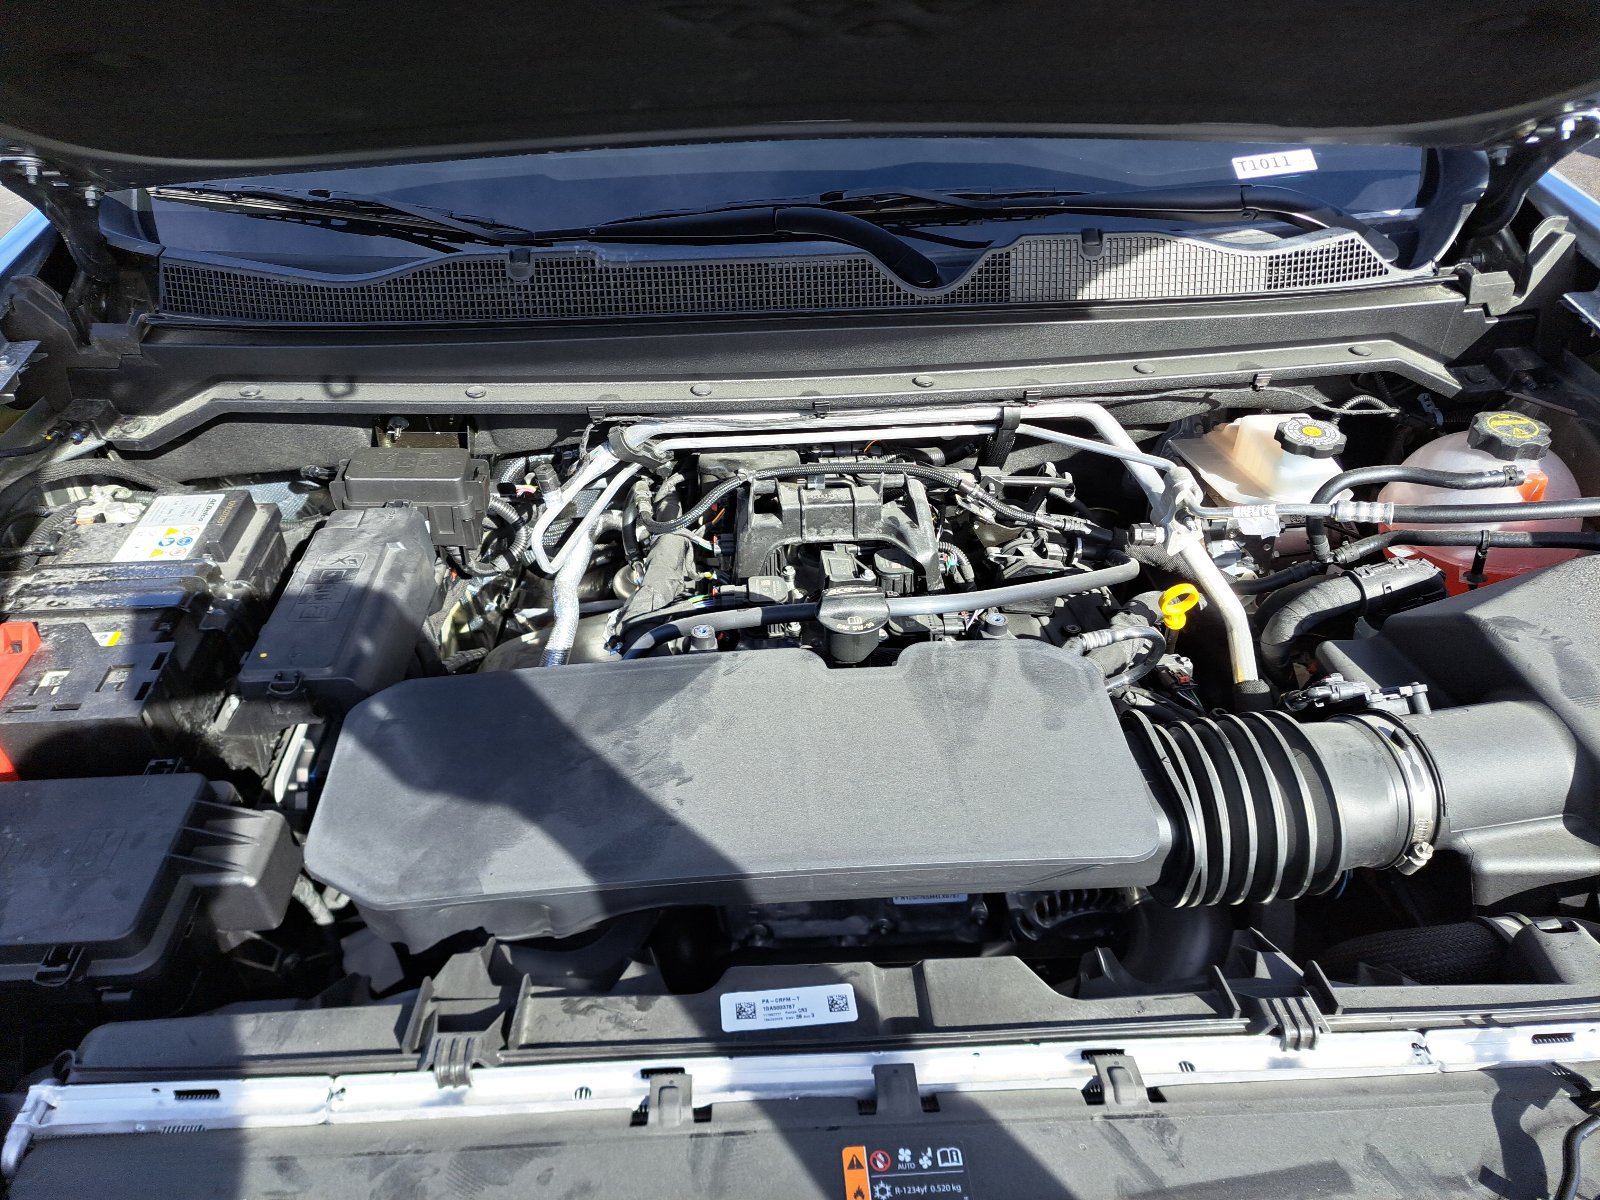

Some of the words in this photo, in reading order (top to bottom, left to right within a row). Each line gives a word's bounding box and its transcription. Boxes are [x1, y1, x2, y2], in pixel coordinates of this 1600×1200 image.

[1237, 155, 1292, 172] T1011
[897, 1162, 916, 1170] AUTO
[894, 1186, 928, 1195] R-1234yf
[930, 1184, 951, 1193] 0.520
[951, 1184, 962, 1193] kg
